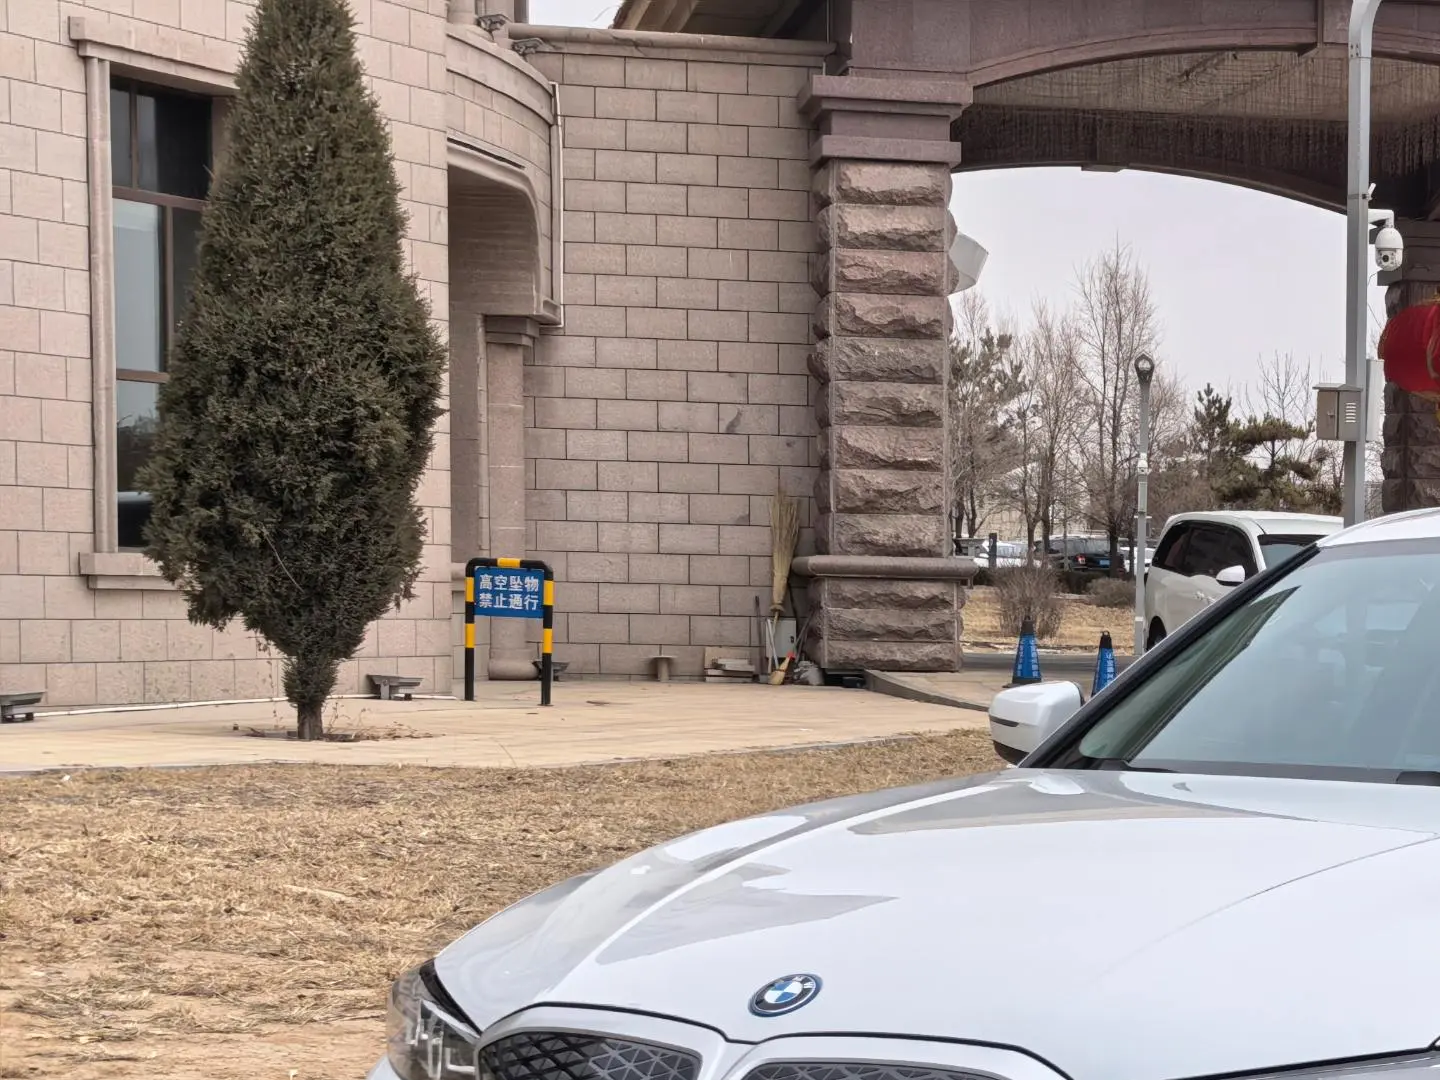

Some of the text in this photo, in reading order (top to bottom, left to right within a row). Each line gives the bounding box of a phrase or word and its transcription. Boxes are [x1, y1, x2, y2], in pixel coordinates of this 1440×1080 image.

[479, 574, 539, 592] 高空坠物
[479, 592, 539, 610] 禁止通行
